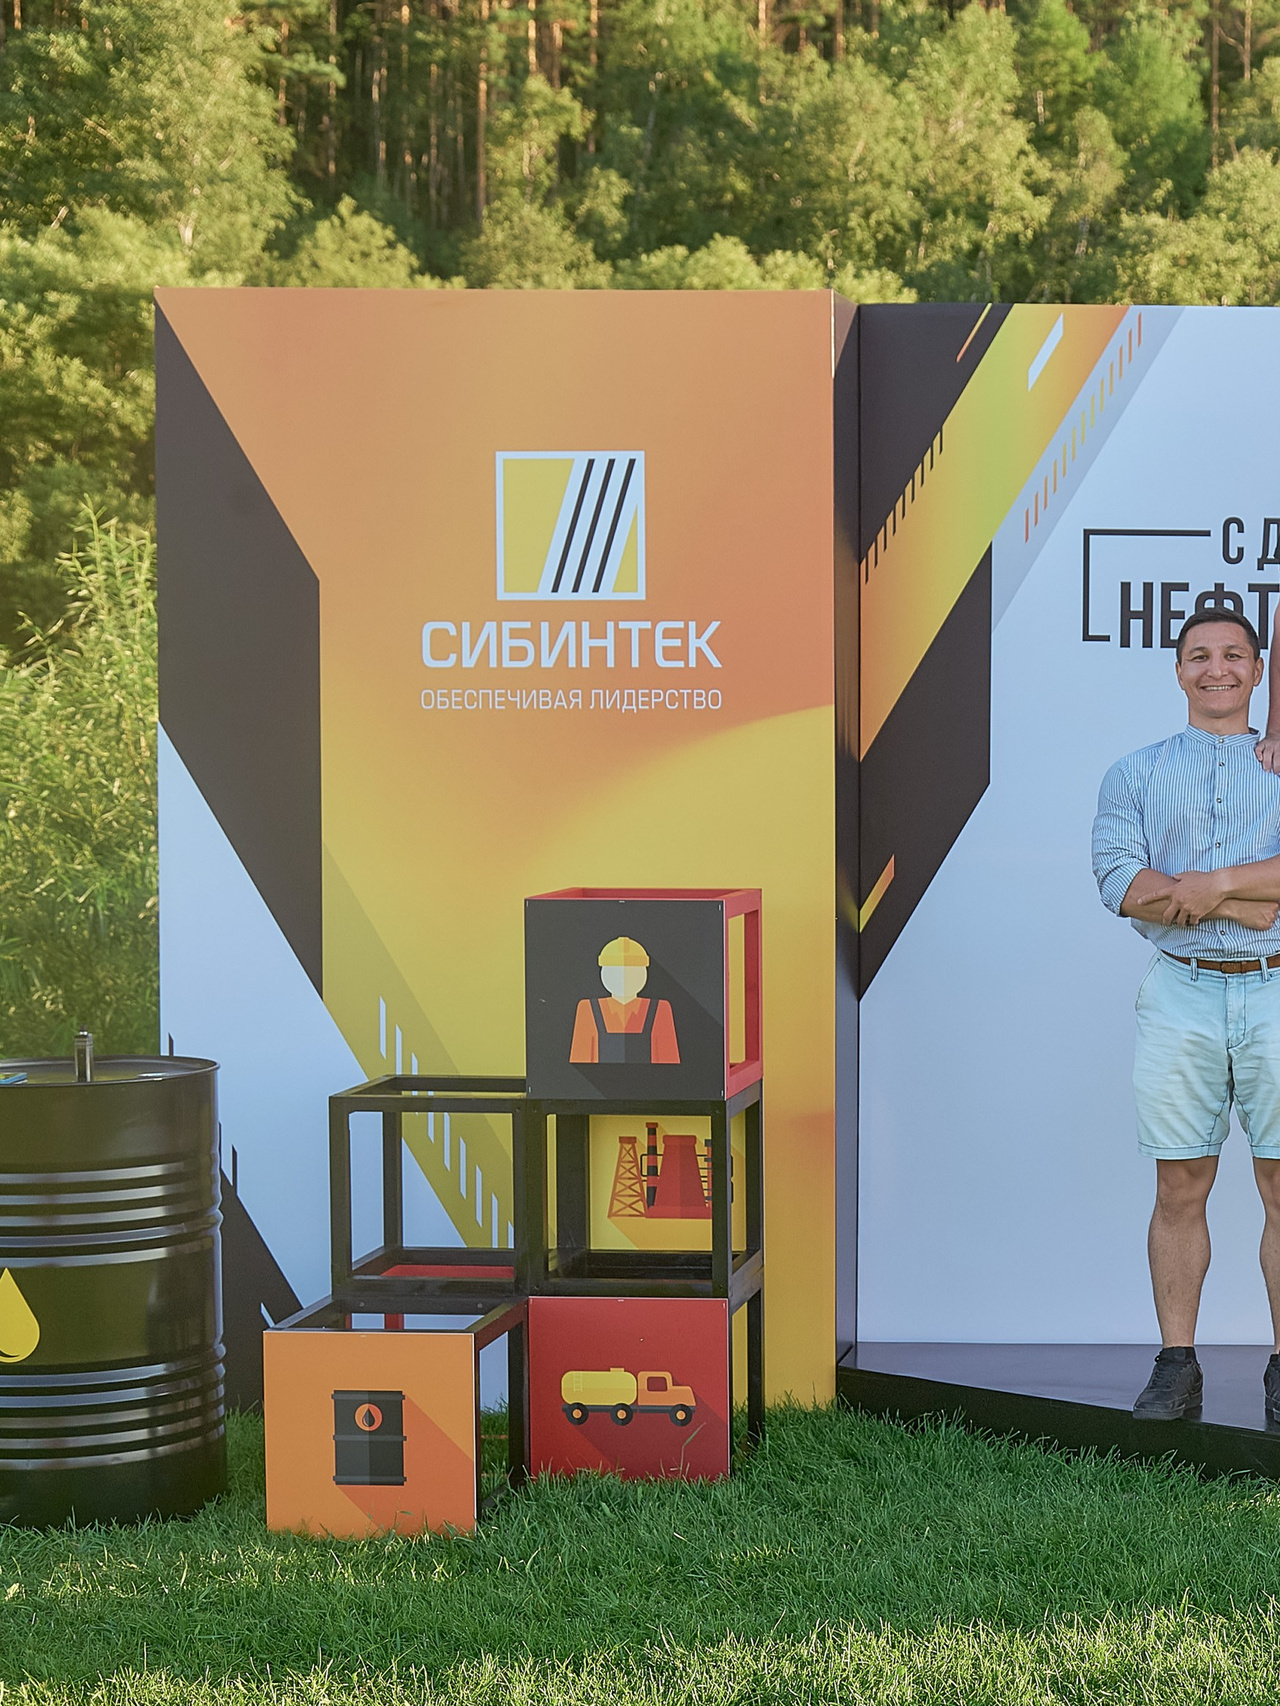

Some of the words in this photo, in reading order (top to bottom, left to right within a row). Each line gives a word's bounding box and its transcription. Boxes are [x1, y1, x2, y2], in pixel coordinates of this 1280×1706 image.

[421, 620, 723, 668] СИБИНТЕК
[420, 689, 582, 710] ОБЕСПЕЧИВАЯ
[589, 688, 723, 713] ЛИДЕРСТВО
